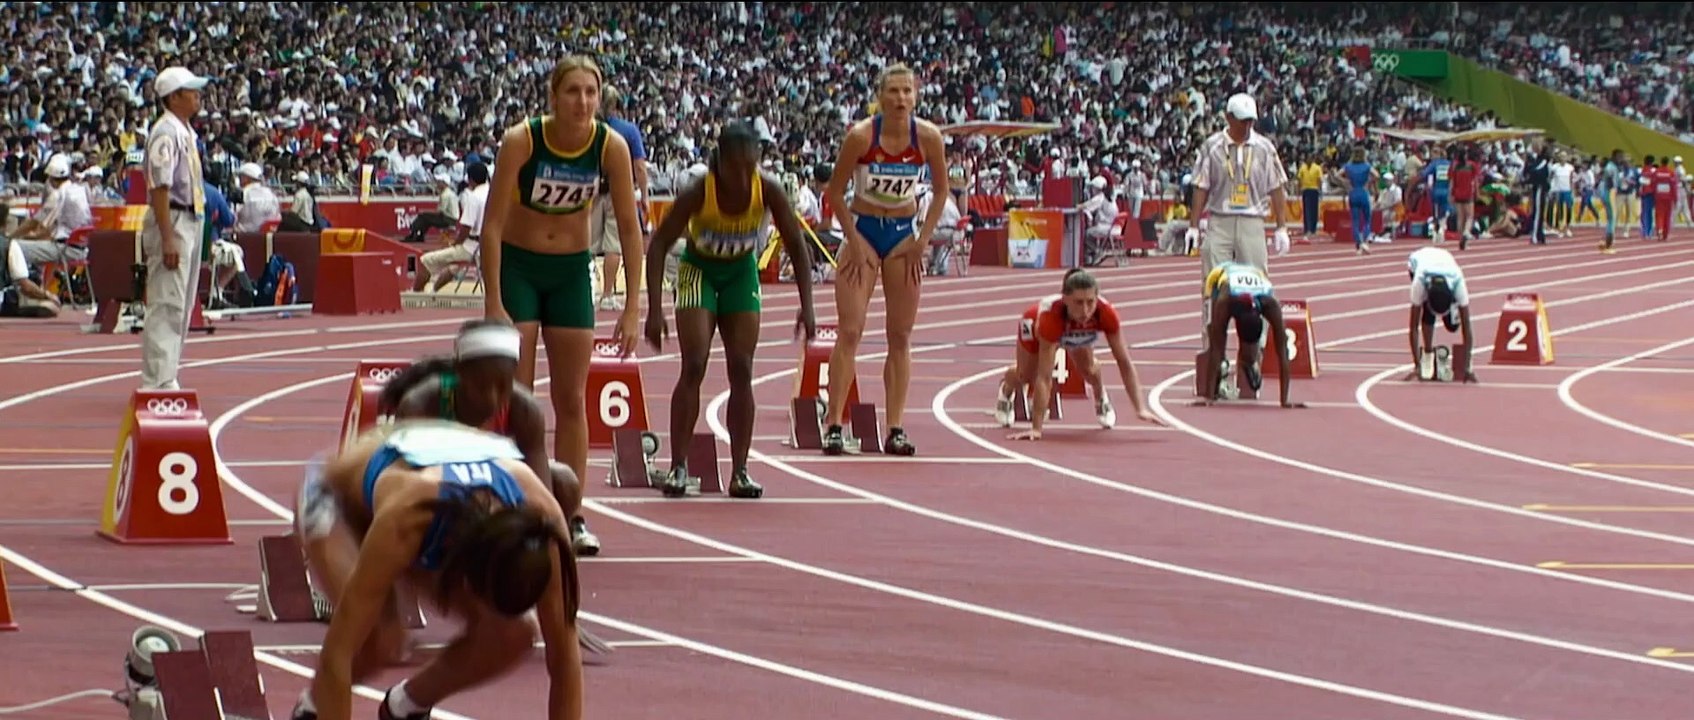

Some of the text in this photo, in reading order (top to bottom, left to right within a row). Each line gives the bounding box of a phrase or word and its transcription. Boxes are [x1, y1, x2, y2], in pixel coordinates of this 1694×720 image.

[871, 178, 914, 197] 2747
[1506, 320, 1528, 351] 2
[1052, 347, 1069, 384] 4
[599, 381, 630, 427] 6
[158, 452, 199, 515] 8
